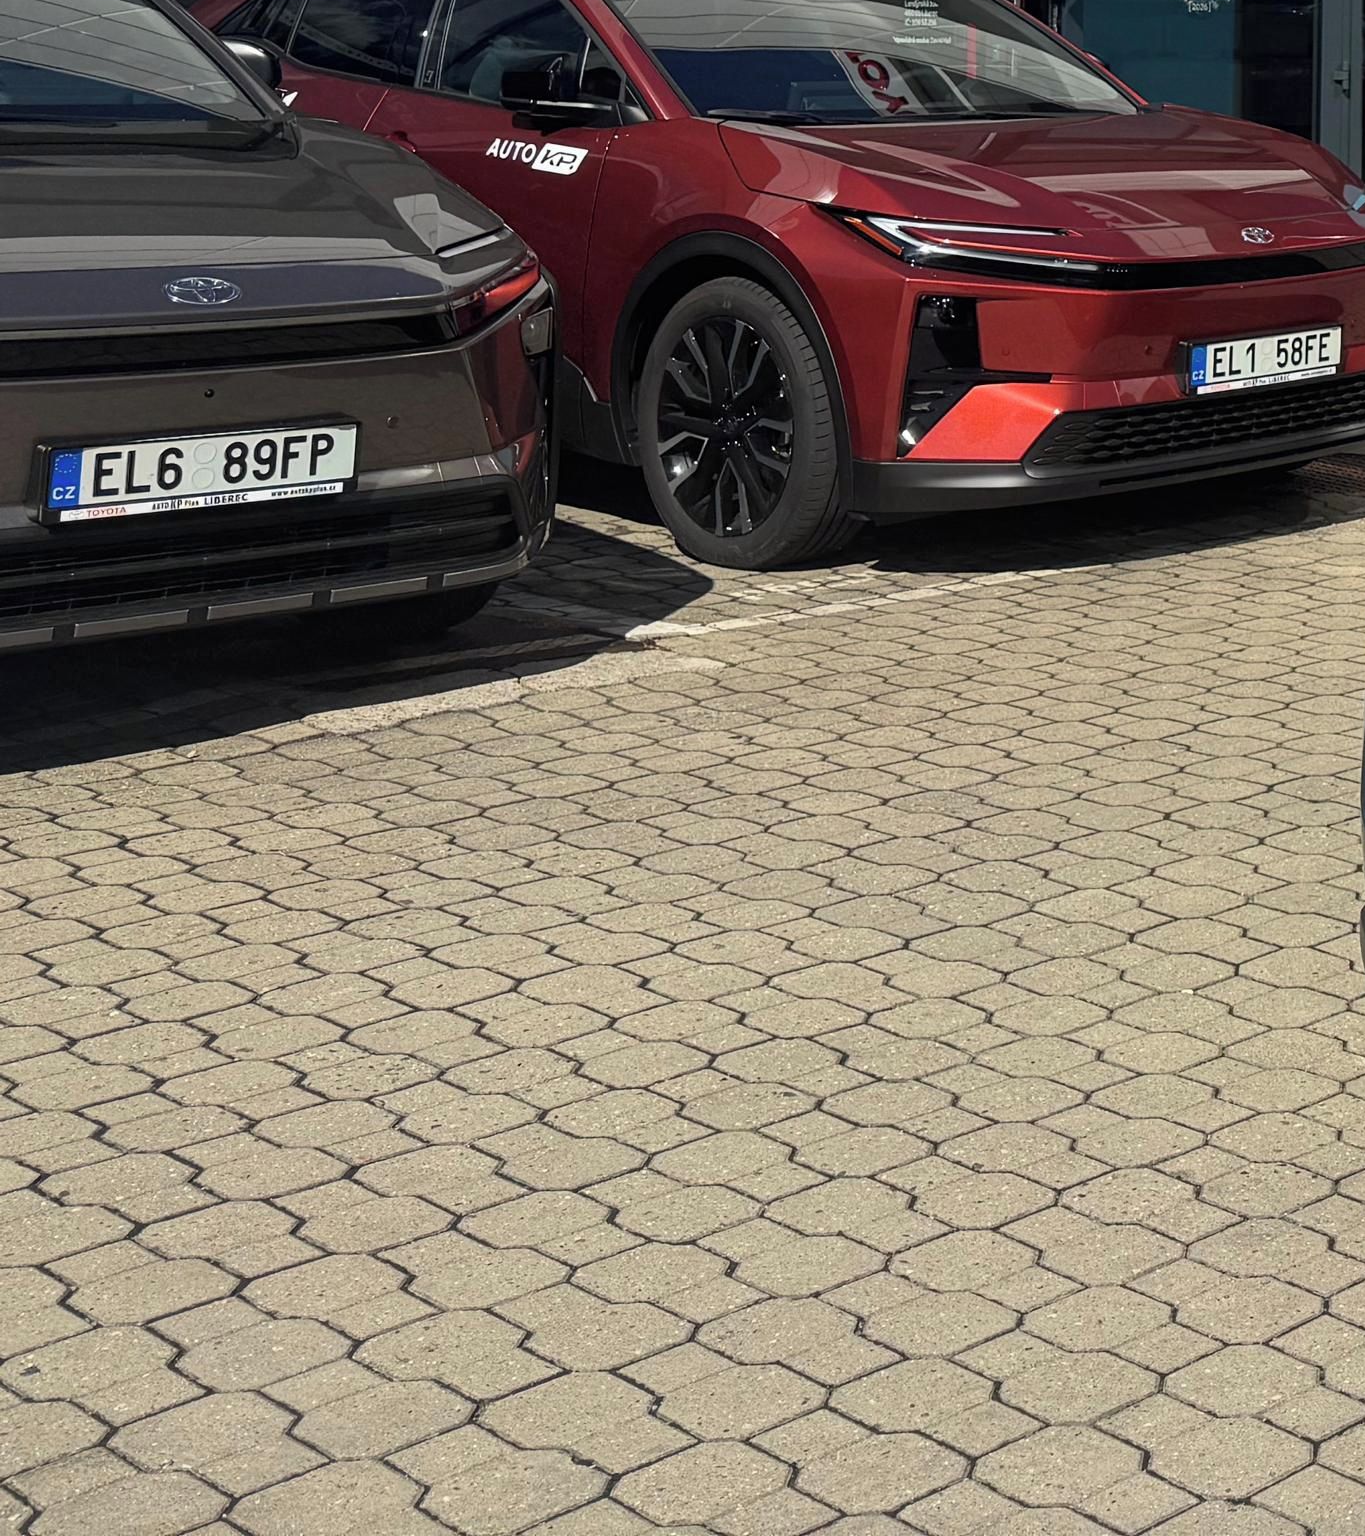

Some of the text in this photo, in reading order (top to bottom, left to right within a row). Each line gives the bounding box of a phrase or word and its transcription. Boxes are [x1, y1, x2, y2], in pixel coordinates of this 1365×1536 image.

[486, 137, 537, 164] AUTO
[1212, 332, 1331, 378] EL1 58FE
[1192, 370, 1204, 381] CZ
[92, 432, 335, 498] EL6 89FP
[52, 486, 76, 501] CZ
[86, 506, 127, 517] TOYOTA
